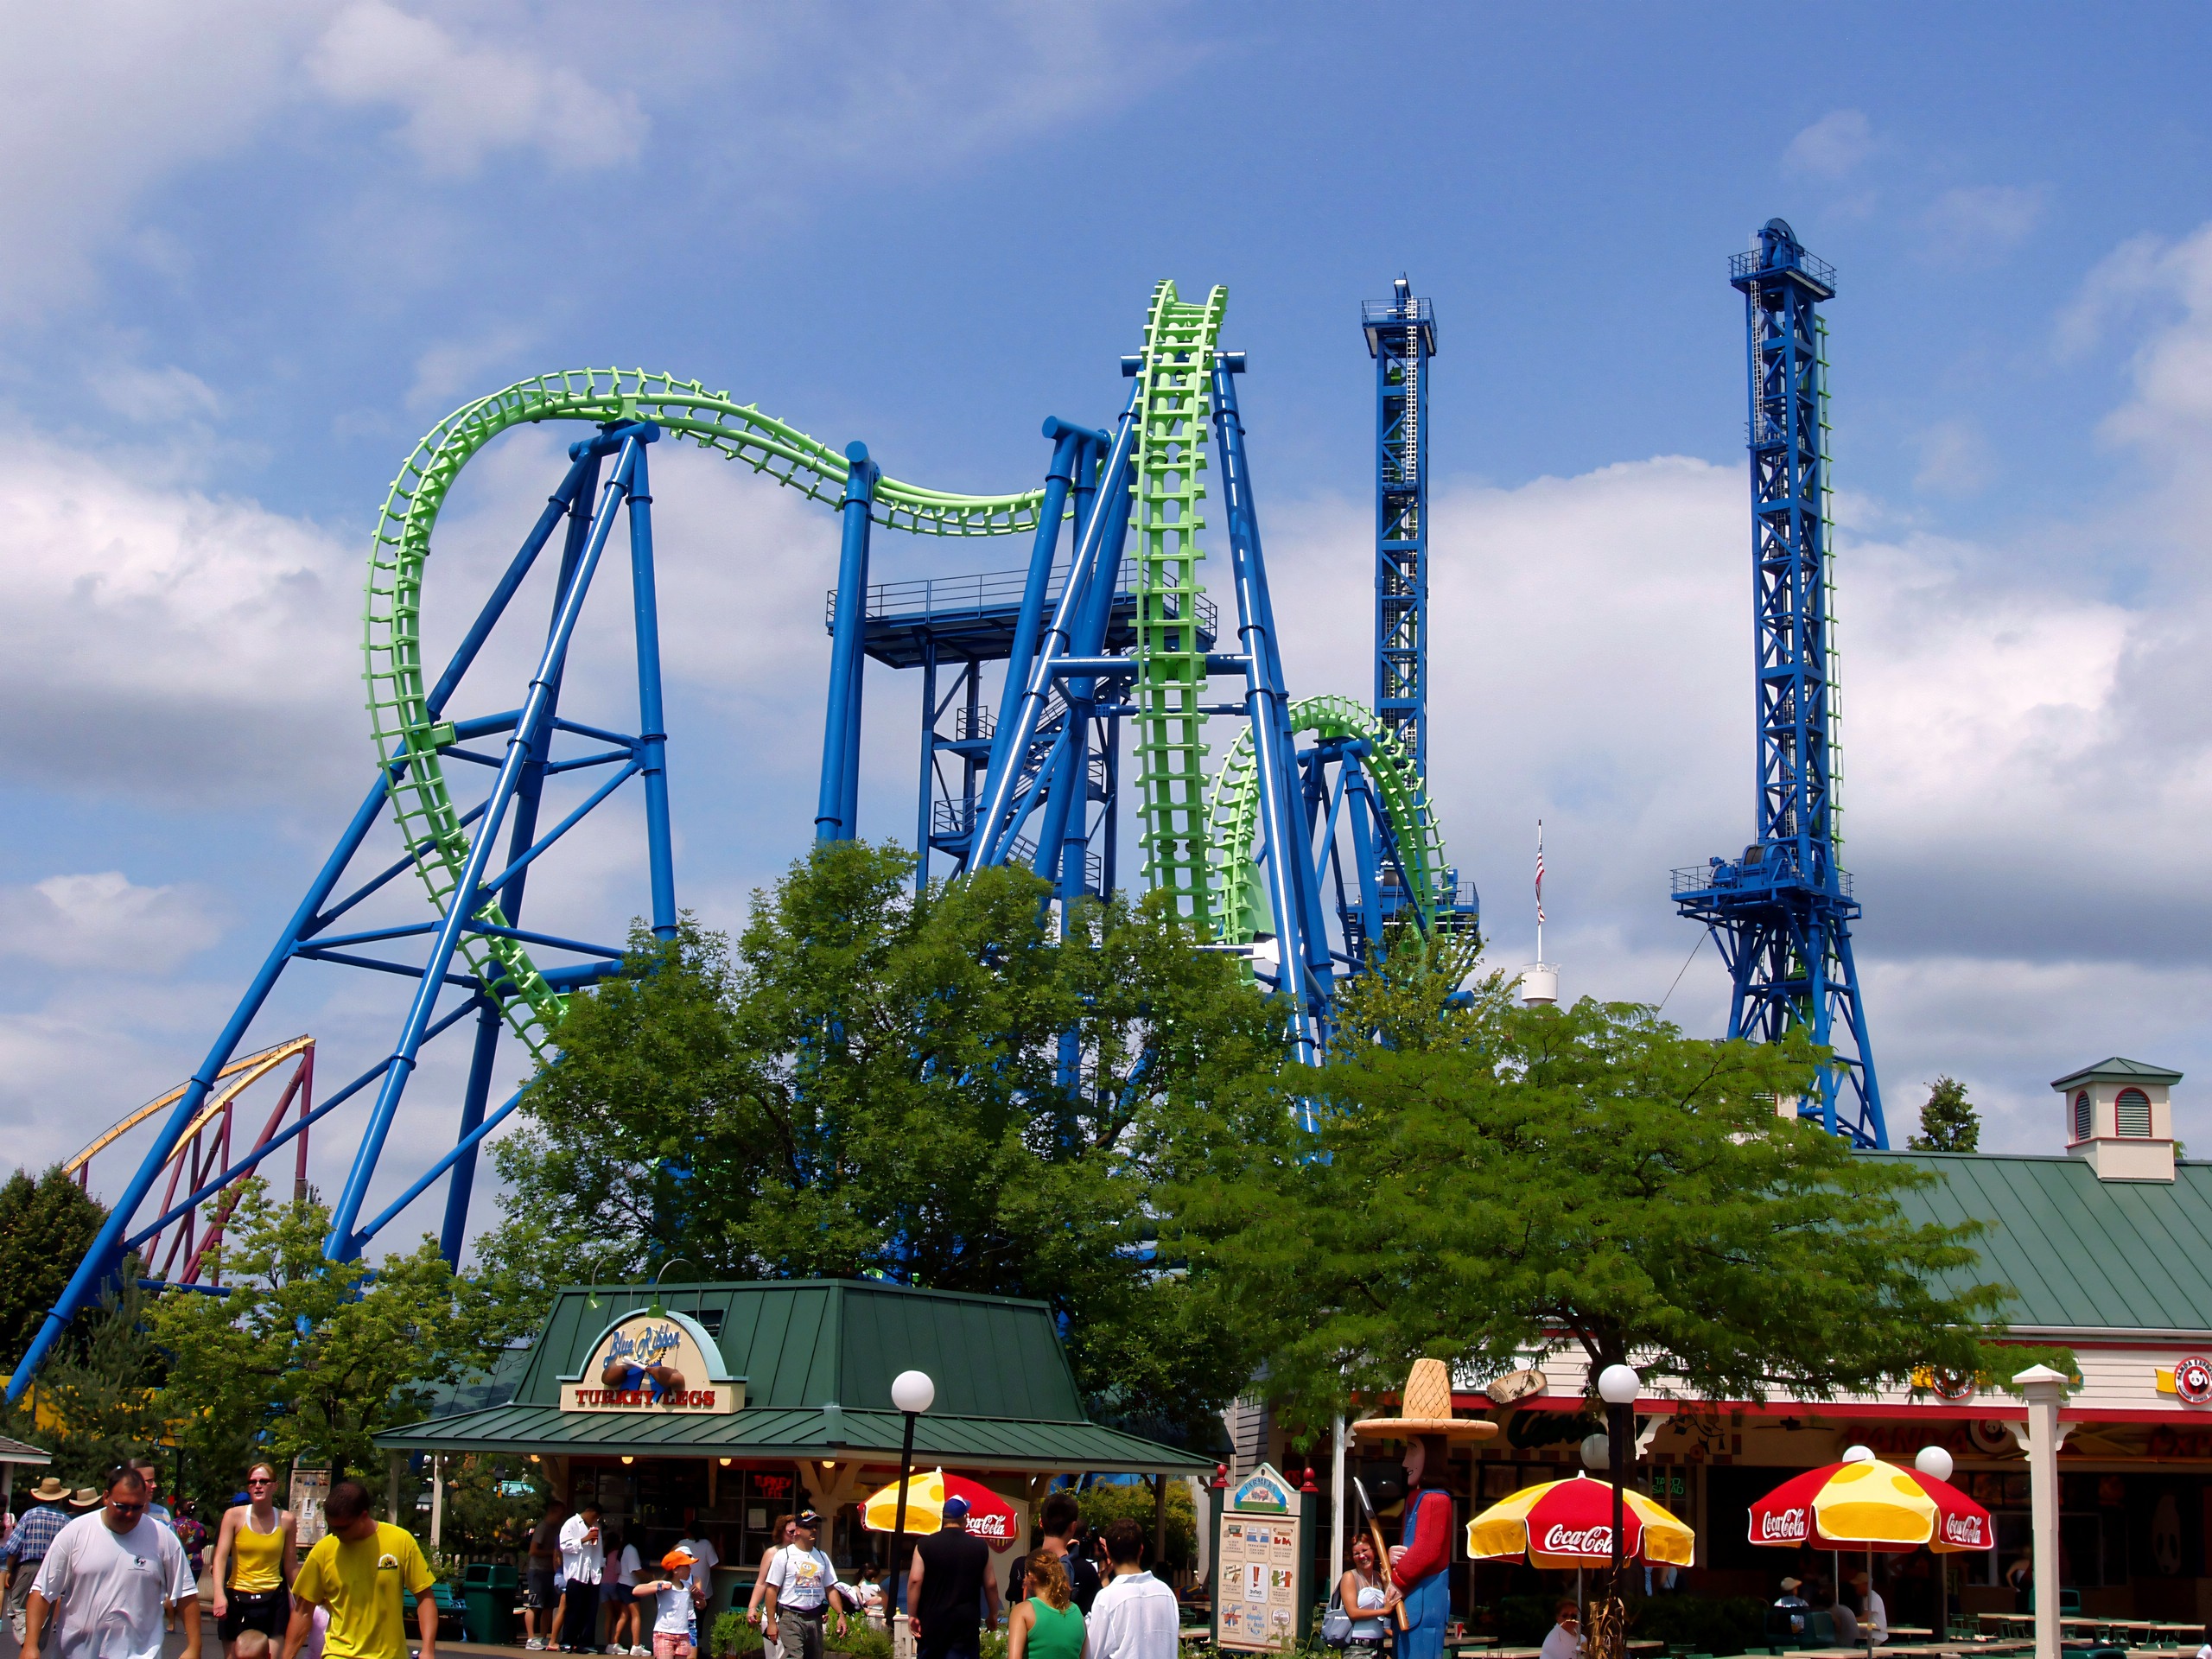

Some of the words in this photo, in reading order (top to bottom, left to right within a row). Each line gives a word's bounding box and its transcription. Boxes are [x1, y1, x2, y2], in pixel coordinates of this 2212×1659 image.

[603, 1331, 634, 1369] Blue
[636, 1323, 681, 1360] Ribbon
[575, 1389, 655, 1406] TURKEY
[663, 1390, 715, 1407] LEGS
[753, 1474, 792, 1488] TURKEY
[1762, 1509, 1804, 1538] Coca-Cola
[1947, 1512, 1981, 1544] Coca-Cola
